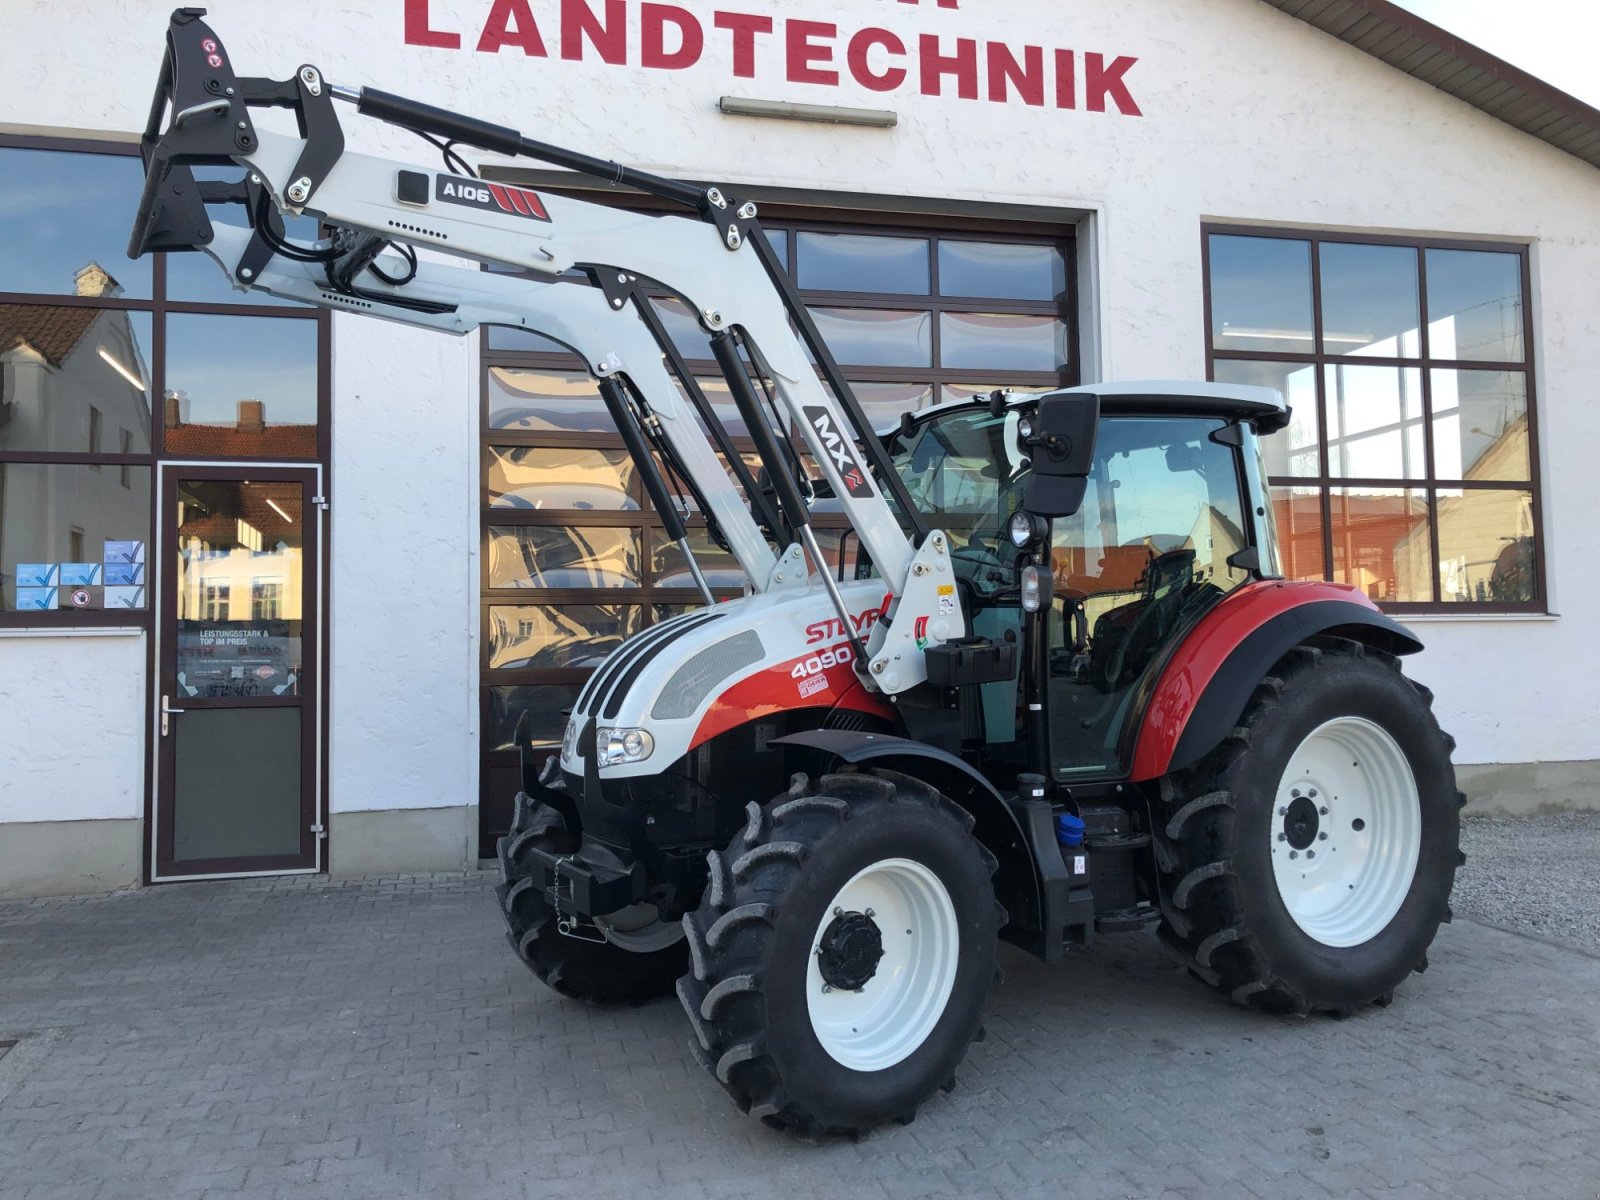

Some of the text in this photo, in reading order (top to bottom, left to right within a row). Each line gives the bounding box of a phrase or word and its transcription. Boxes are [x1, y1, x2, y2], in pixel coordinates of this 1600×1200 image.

[404, 0, 1144, 117] LANDTECHNIK
[443, 182, 490, 203] A106
[813, 413, 854, 473] MX
[200, 630, 269, 638] LEISTUNGSSTARK &
[791, 647, 852, 679] 4090
